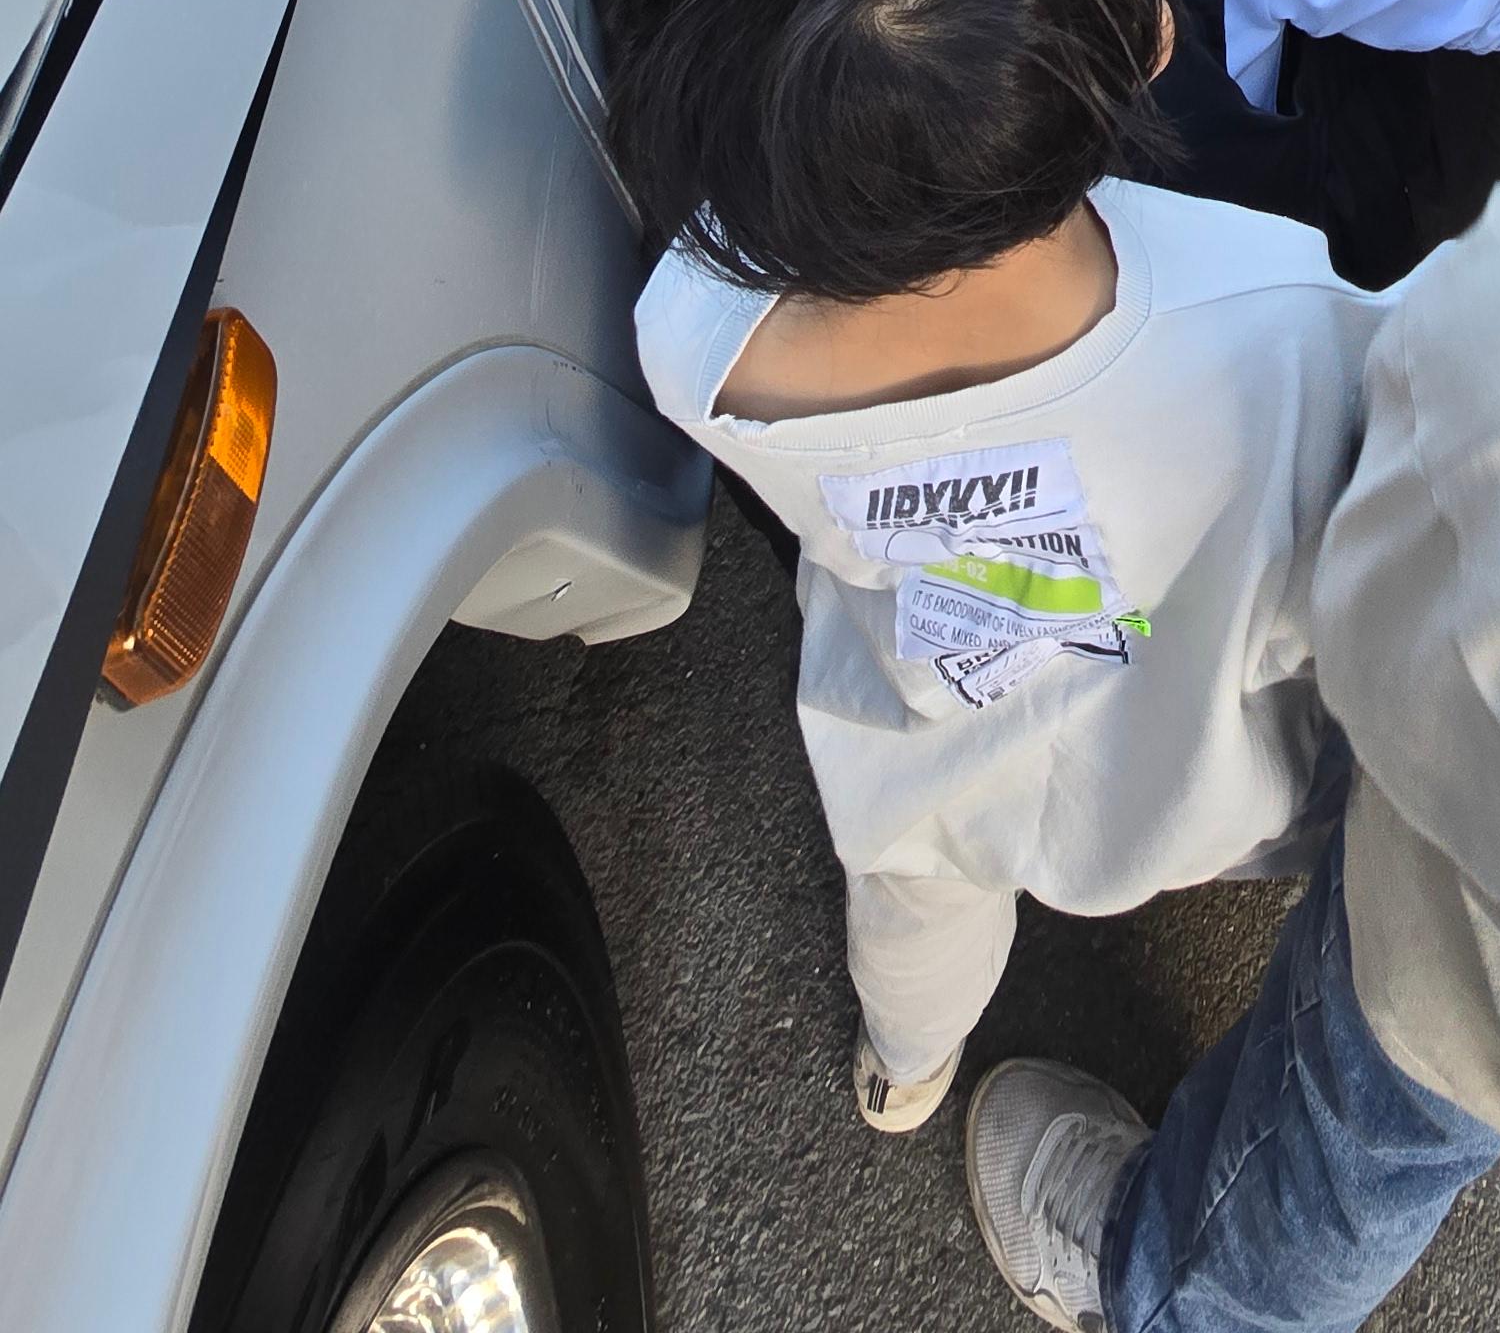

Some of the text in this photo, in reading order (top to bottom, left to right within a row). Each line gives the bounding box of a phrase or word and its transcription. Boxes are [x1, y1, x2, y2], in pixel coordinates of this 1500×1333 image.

[910, 614, 948, 640] CLASSIC
[951, 627, 982, 647] MIXED
[912, 590, 923, 605] IT
[922, 593, 934, 610] IS
[992, 615, 1005, 632] OF
[1007, 619, 1034, 637] LIVELY
